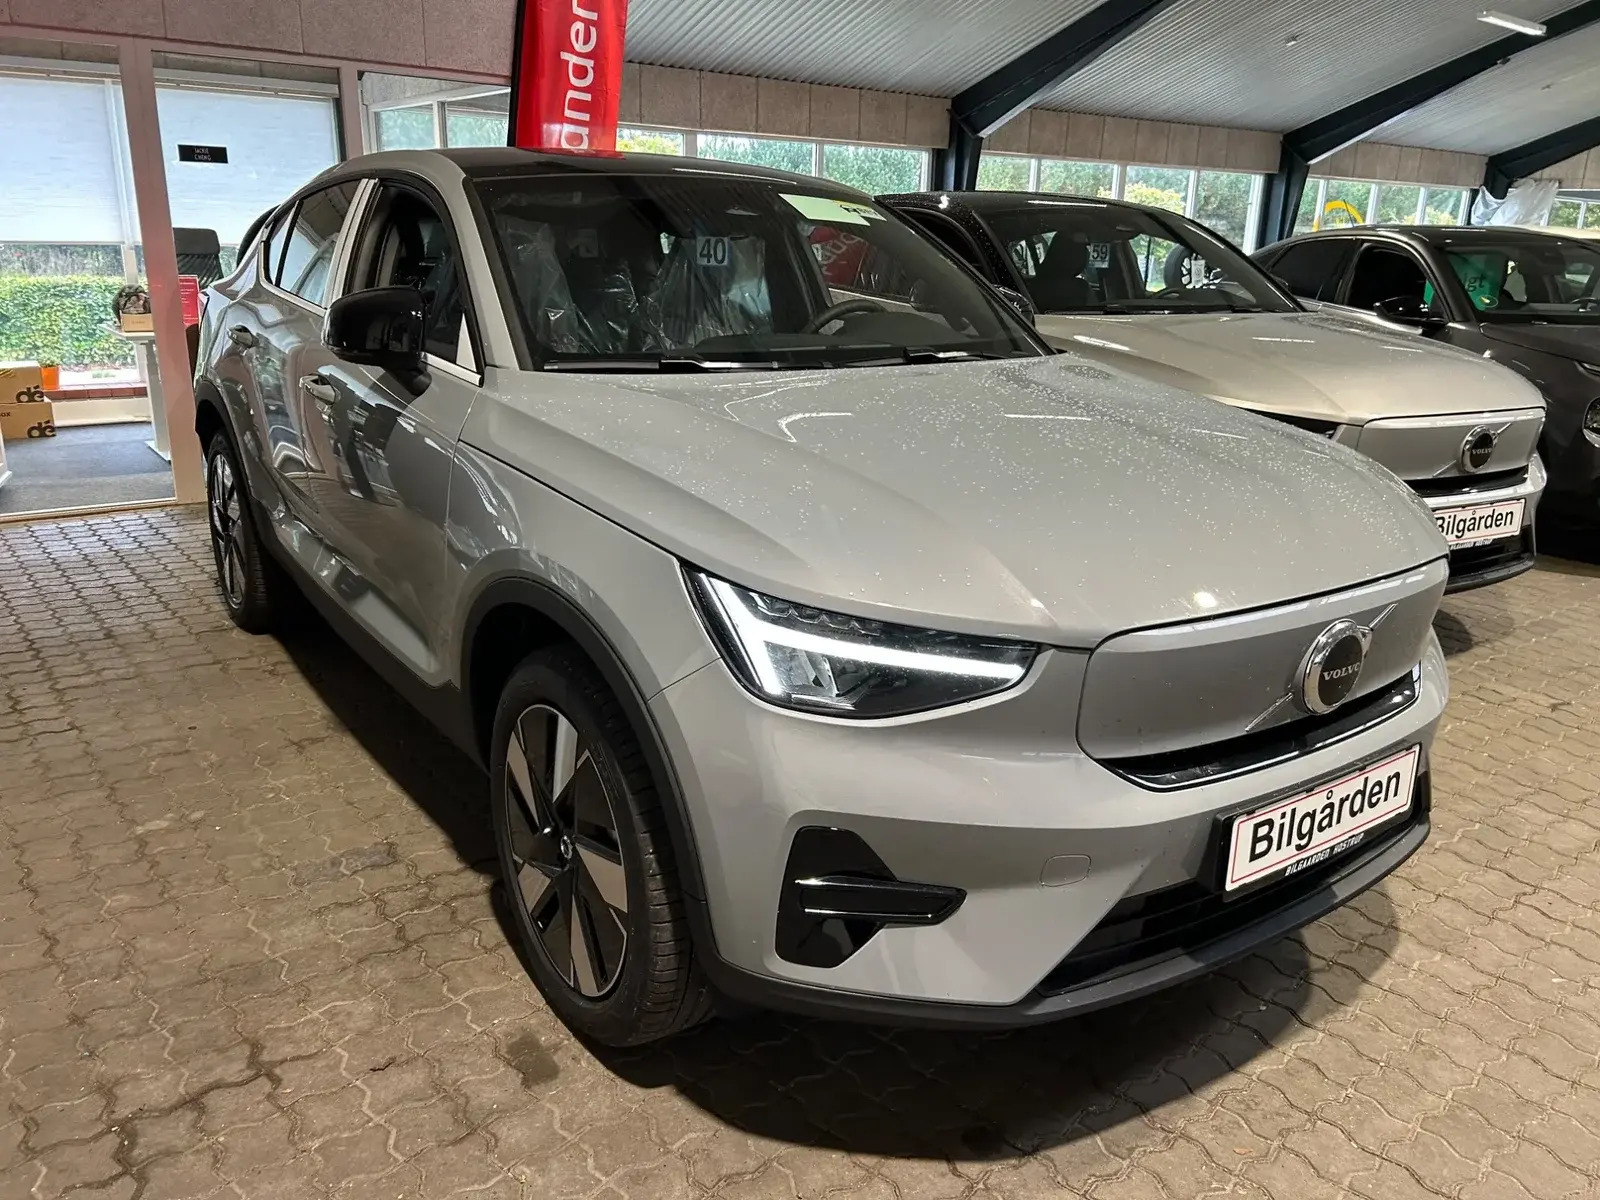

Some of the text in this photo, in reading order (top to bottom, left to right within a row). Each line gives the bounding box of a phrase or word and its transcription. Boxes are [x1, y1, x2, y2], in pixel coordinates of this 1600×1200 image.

[699, 237, 727, 265] 40
[1092, 244, 1108, 260] 59
[27, 419, 56, 438] dé
[1435, 509, 1514, 539] Bilgården
[1322, 662, 1361, 681] VOLVO
[1248, 770, 1401, 864] Bilgården
[1284, 848, 1330, 877] BILGAARDEN
